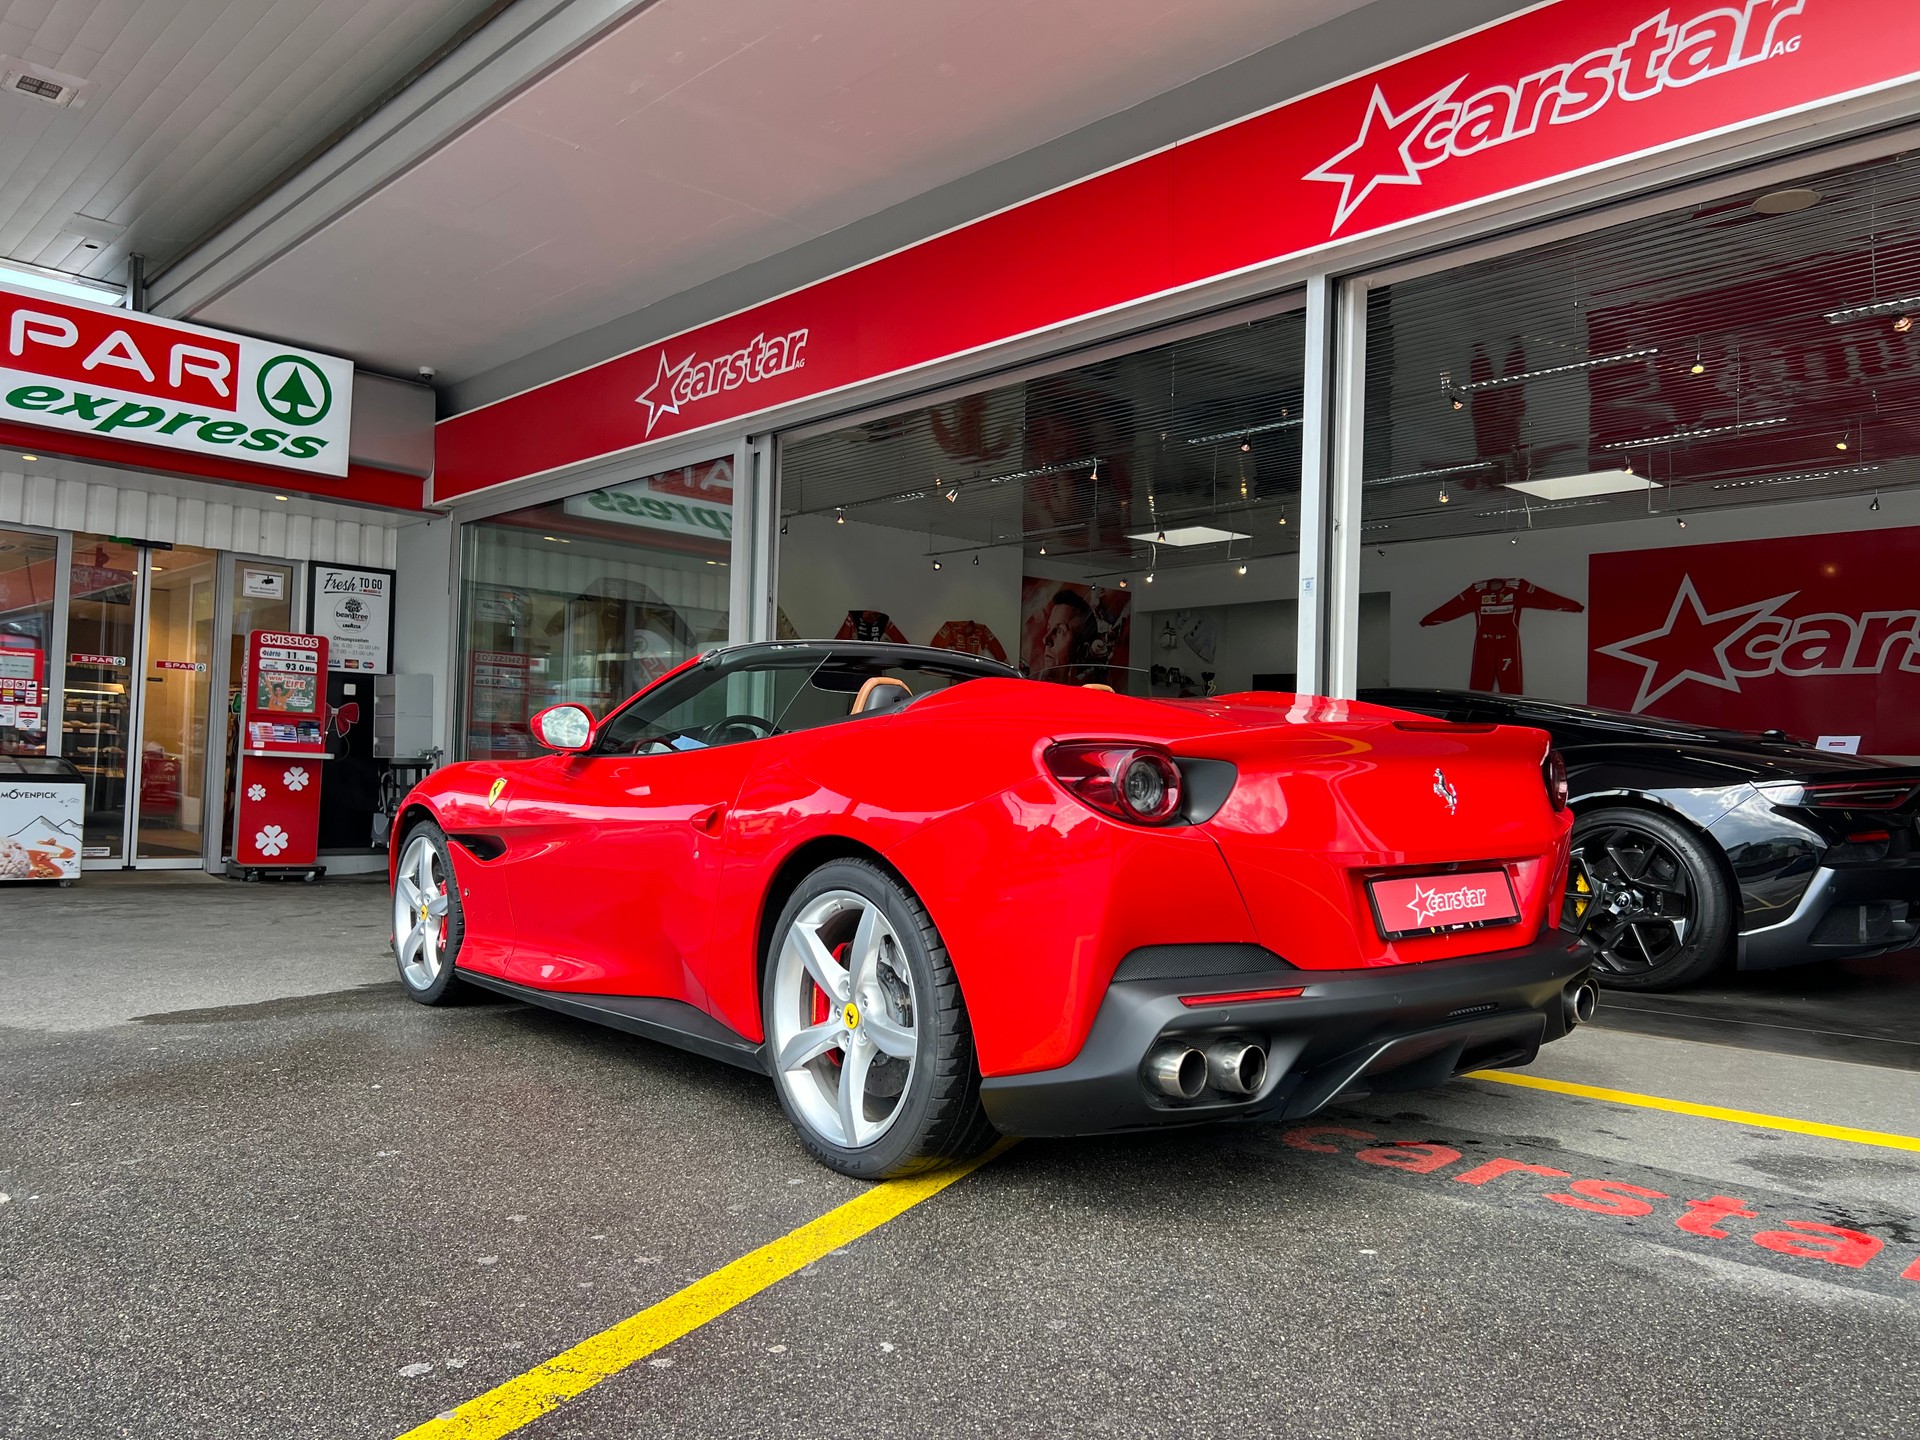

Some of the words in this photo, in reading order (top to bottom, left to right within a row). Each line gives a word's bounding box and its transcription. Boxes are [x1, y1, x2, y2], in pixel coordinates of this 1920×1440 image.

[1768, 34, 1802, 59] AG
[1399, 0, 1806, 171] carstar
[671, 328, 809, 406] carstar
[795, 358, 806, 370] AG
[5, 384, 330, 459] express
[324, 572, 358, 592] Fresh
[359, 577, 370, 589] TO
[372, 578, 383, 590] GO
[261, 634, 319, 648] SWISSLOS
[81, 655, 114, 664] SPAR
[164, 661, 195, 670] SPAR
[285, 680, 306, 689] LIFE
[1426, 886, 1487, 914] carstar
